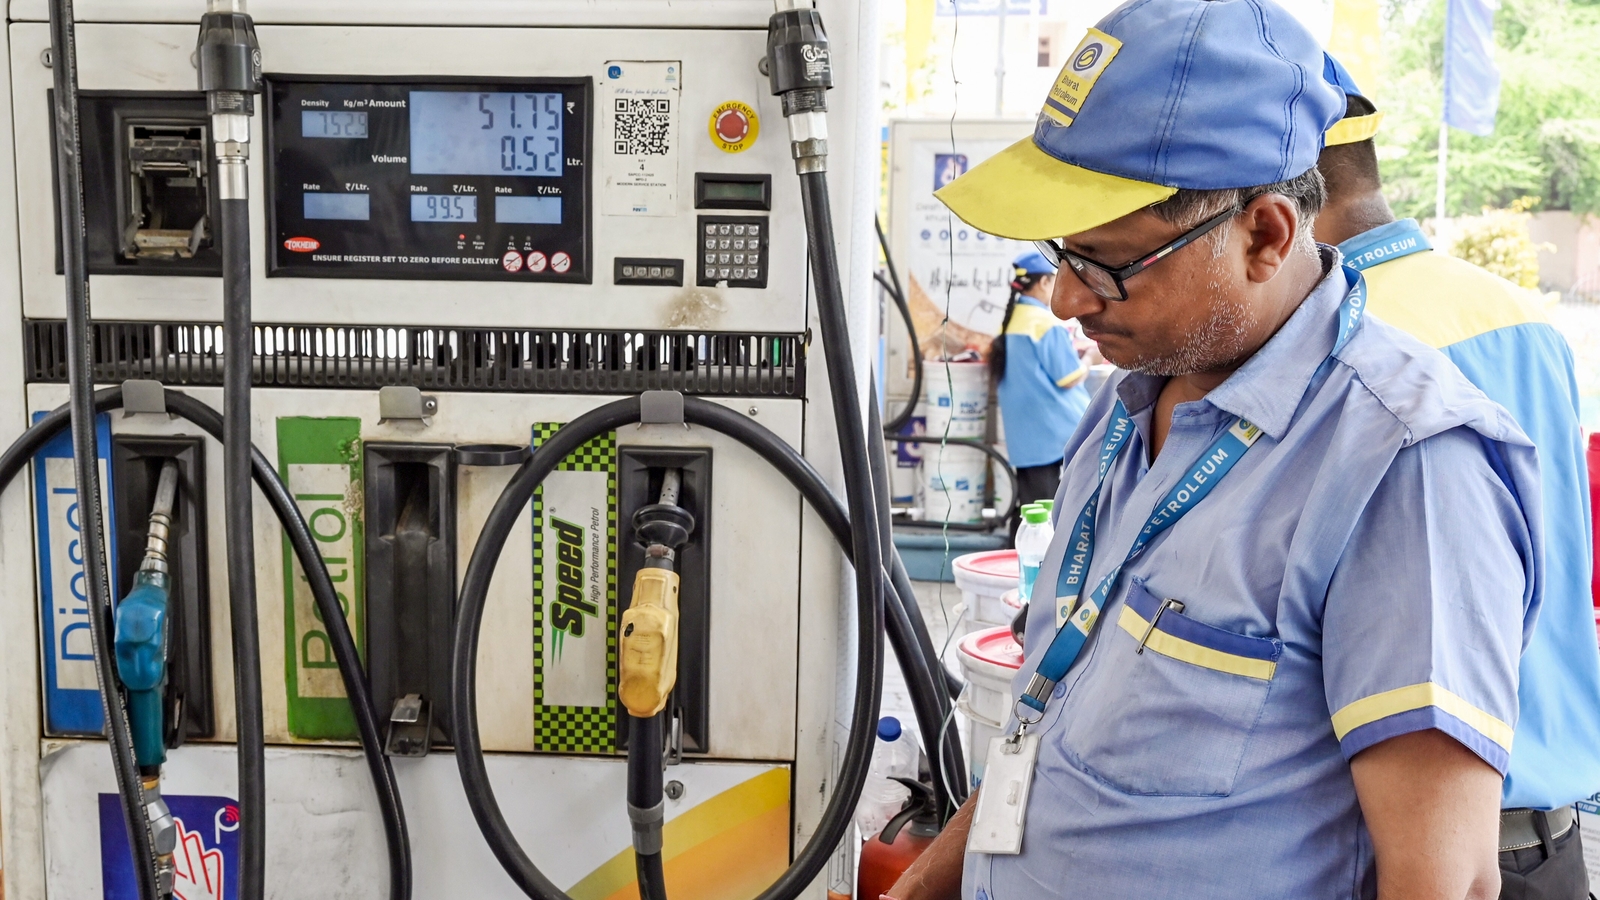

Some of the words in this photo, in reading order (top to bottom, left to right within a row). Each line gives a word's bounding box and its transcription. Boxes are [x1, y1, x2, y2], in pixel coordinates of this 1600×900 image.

[1053, 84, 1078, 106] Petroleum
[1061, 75, 1080, 92] Bharat
[301, 100, 330, 108] Density
[368, 100, 406, 108] Amount
[478, 94, 560, 130] 51.75
[712, 102, 755, 119] EMERGENCY
[318, 112, 368, 136] 752.9
[501, 136, 560, 172] 0.52
[722, 142, 744, 151] STOP
[372, 155, 408, 163] Volume
[567, 158, 584, 166] Ltr.
[284, 240, 318, 250] TOKHEIM
[1346, 237, 1417, 270] ETROLEUM
[1066, 520, 1093, 585] BHARAT
[1085, 418, 1129, 518] PEOLEUM
[1143, 448, 1228, 534] PETROLEUM
[590, 507, 599, 531] Petrol
[590, 532, 599, 584] Performance
[550, 515, 598, 638] Speed
[591, 584, 601, 603] High
[122, 709, 133, 747] DISPENSING
